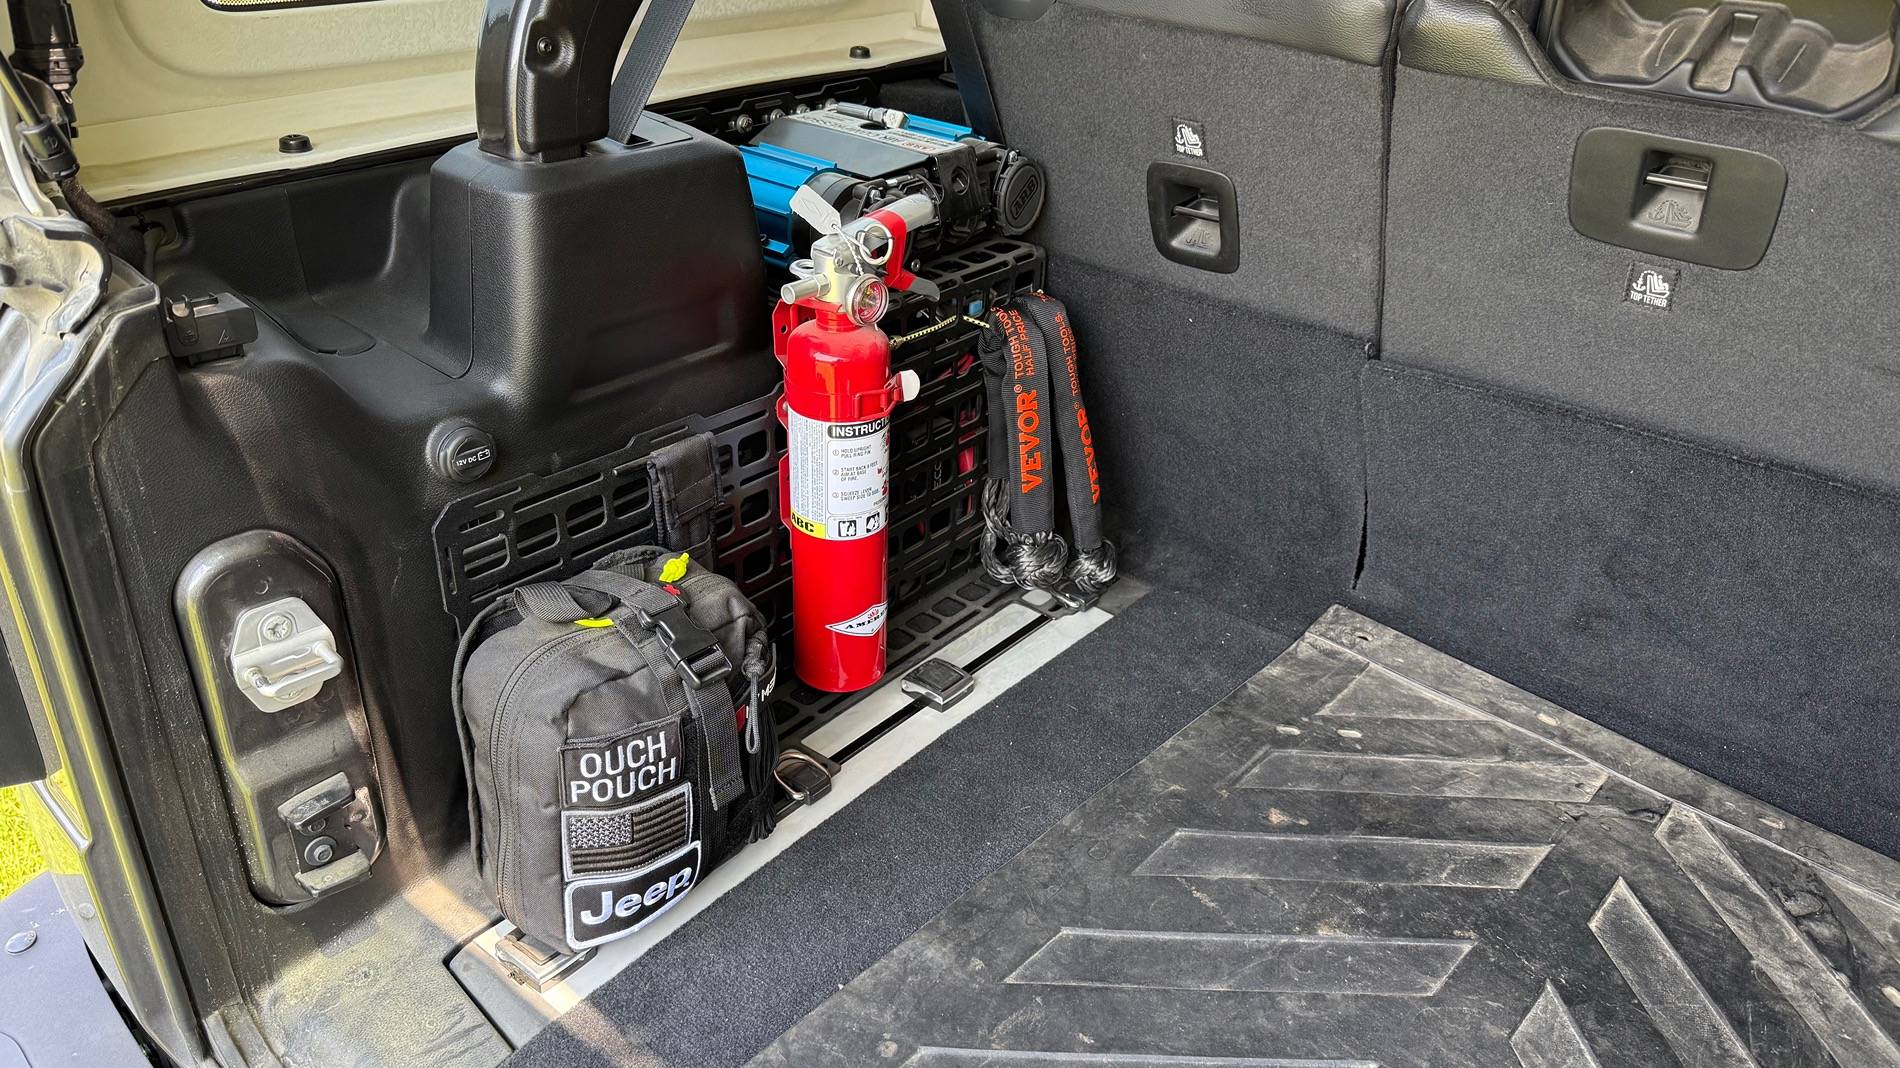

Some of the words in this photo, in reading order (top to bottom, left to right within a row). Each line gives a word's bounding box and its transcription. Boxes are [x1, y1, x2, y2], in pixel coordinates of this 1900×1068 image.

[1630, 290, 1643, 301] TOP
[1643, 294, 1667, 307] TETHER
[1009, 309, 1031, 340] PRICE
[1054, 311, 1071, 354] TOOLS
[1008, 334, 1025, 380] TOUGH
[1022, 344, 1035, 377] HALF
[1066, 355, 1080, 397] TOUGH
[791, 511, 815, 533] ABC
[580, 731, 667, 778] OUCH
[570, 757, 677, 803] POUCH
[580, 866, 693, 926] Jeep
